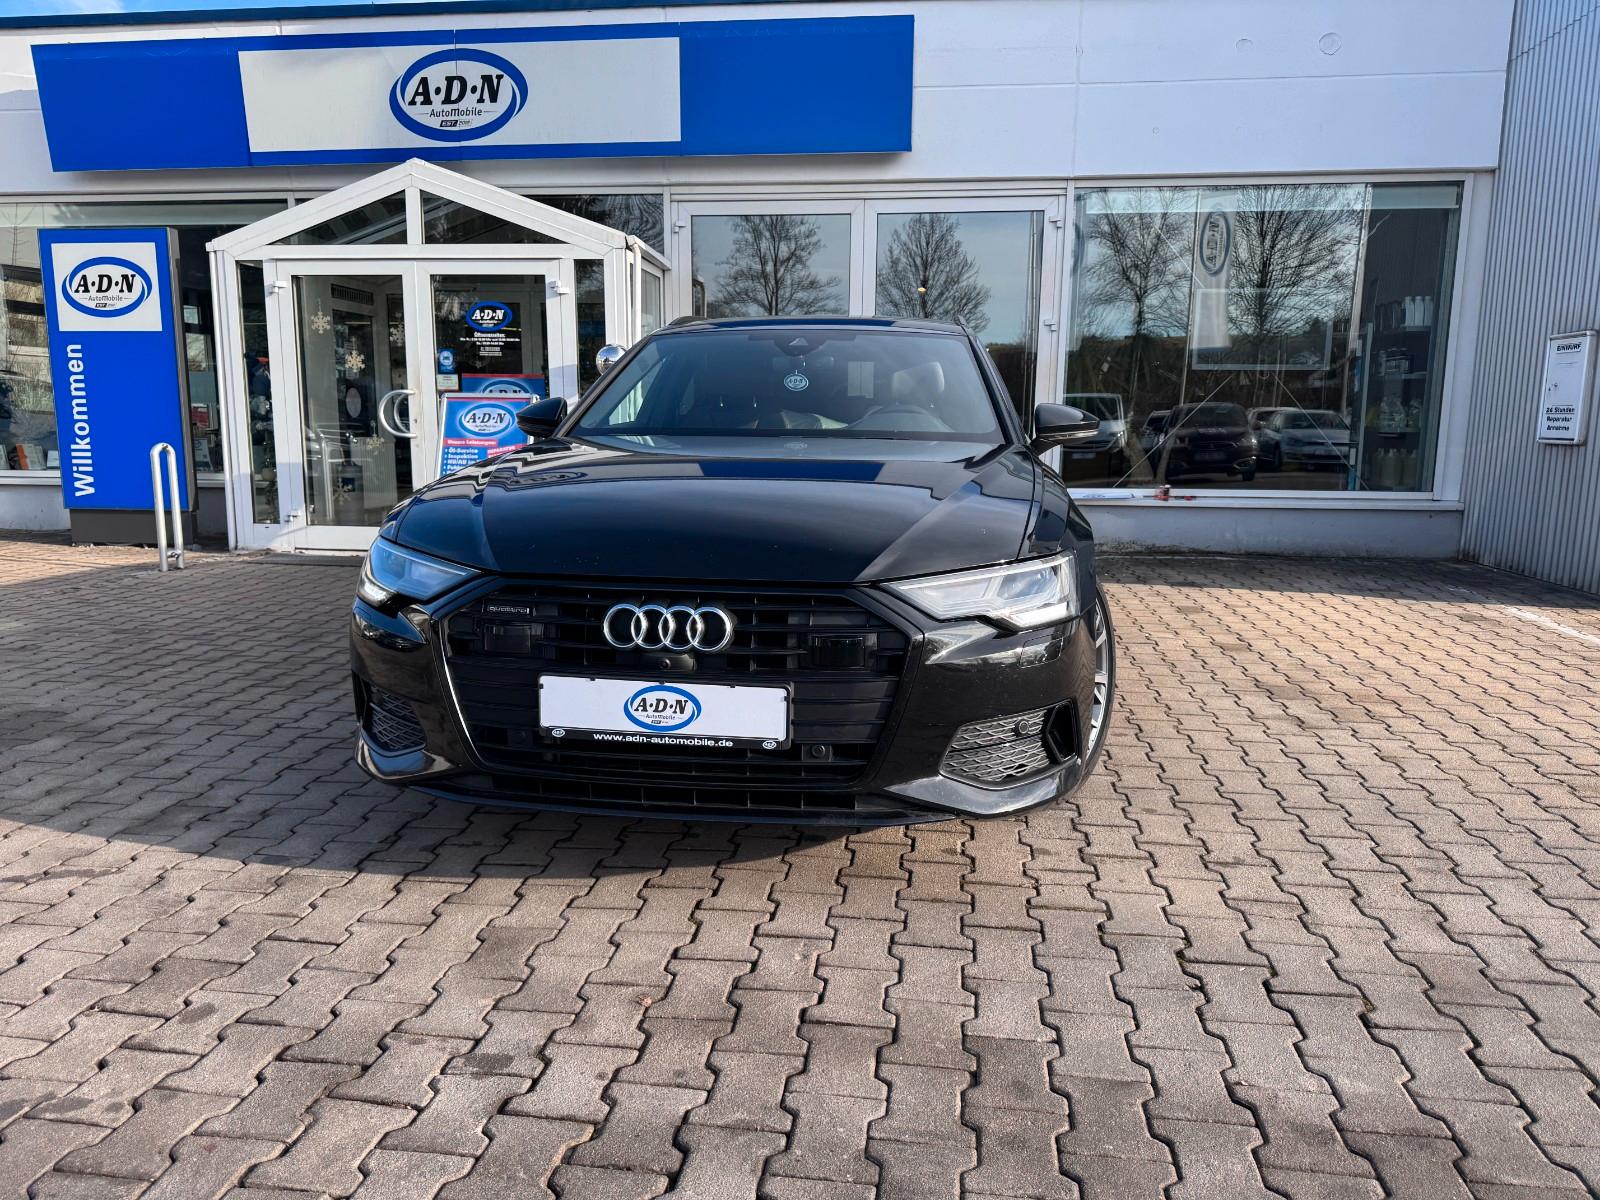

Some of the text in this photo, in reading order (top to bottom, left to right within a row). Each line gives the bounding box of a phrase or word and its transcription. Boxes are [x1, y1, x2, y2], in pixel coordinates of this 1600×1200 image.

[429, 107, 482, 118] AutoMobile
[67, 344, 95, 496] Willkommen
[593, 732, 734, 748] www.adn-automobile.de
